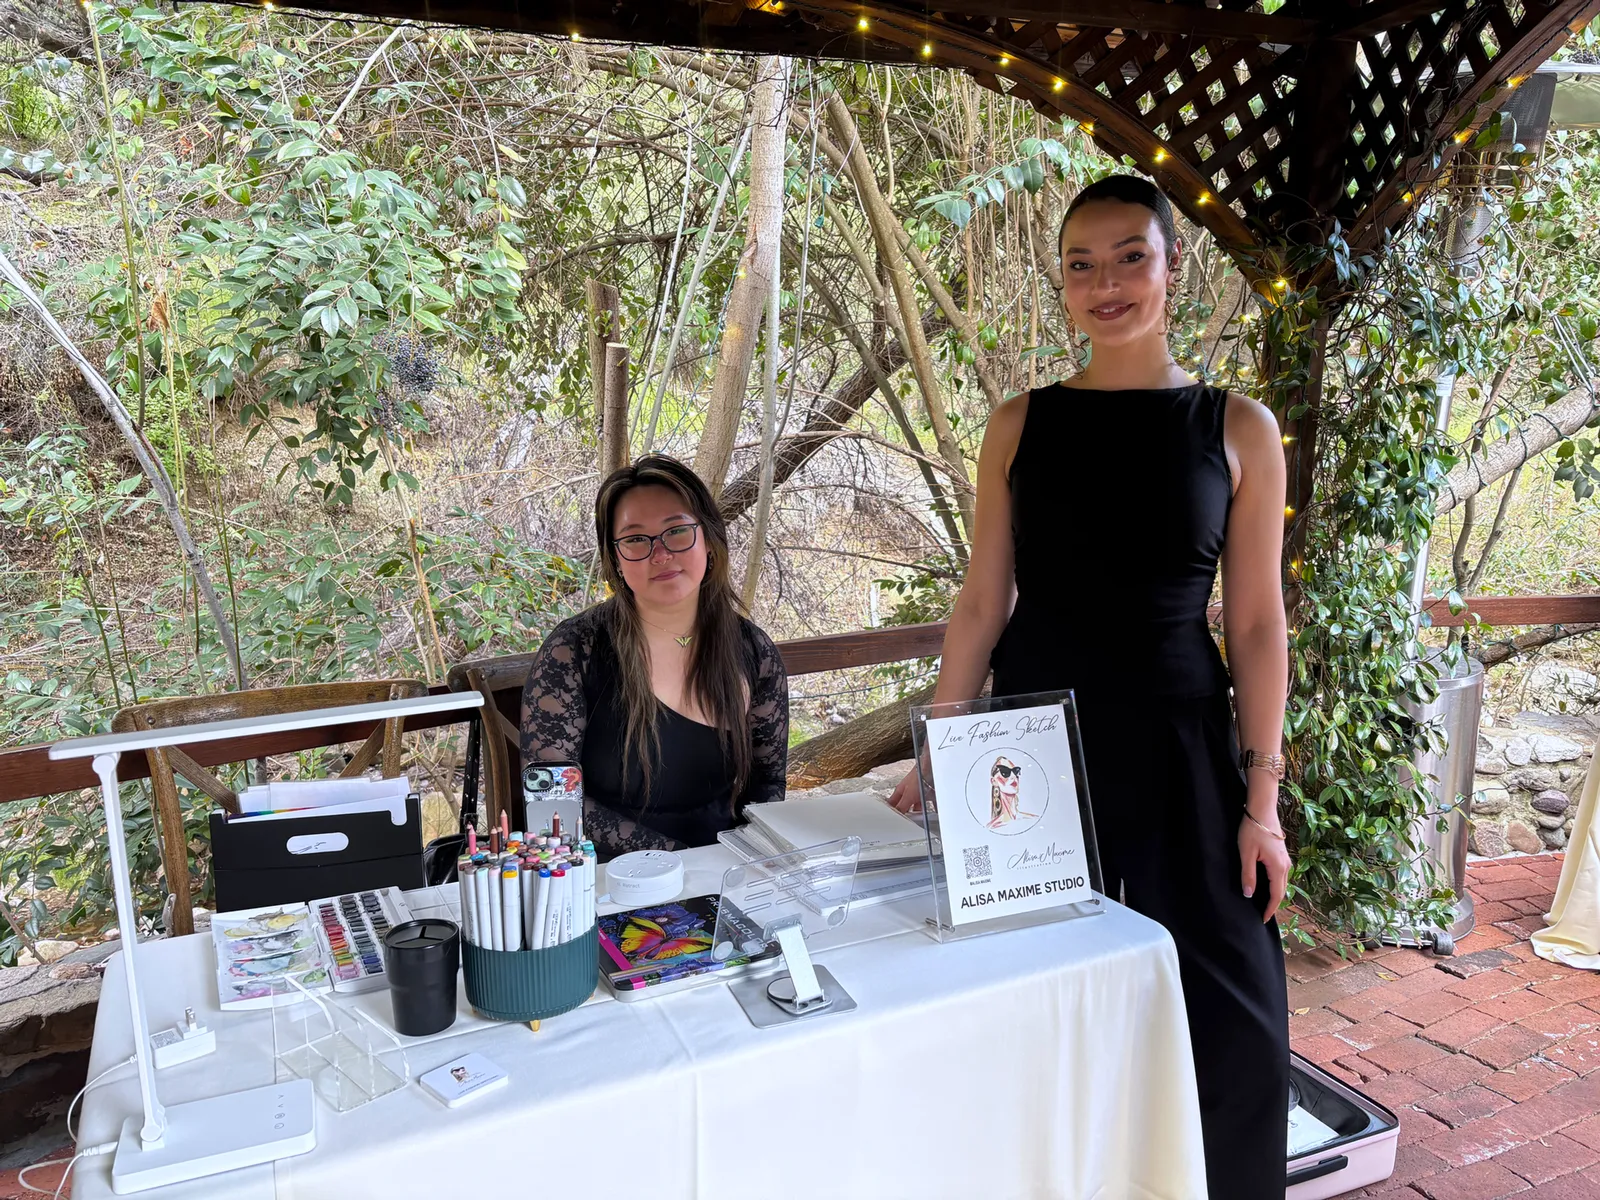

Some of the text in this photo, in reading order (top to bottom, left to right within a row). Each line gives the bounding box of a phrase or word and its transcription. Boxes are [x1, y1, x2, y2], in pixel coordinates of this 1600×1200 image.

[968, 720, 1011, 746] Fashion
[1015, 714, 1059, 741] Sketch
[961, 876, 1085, 909] ALISA MAXIME STUDIO
